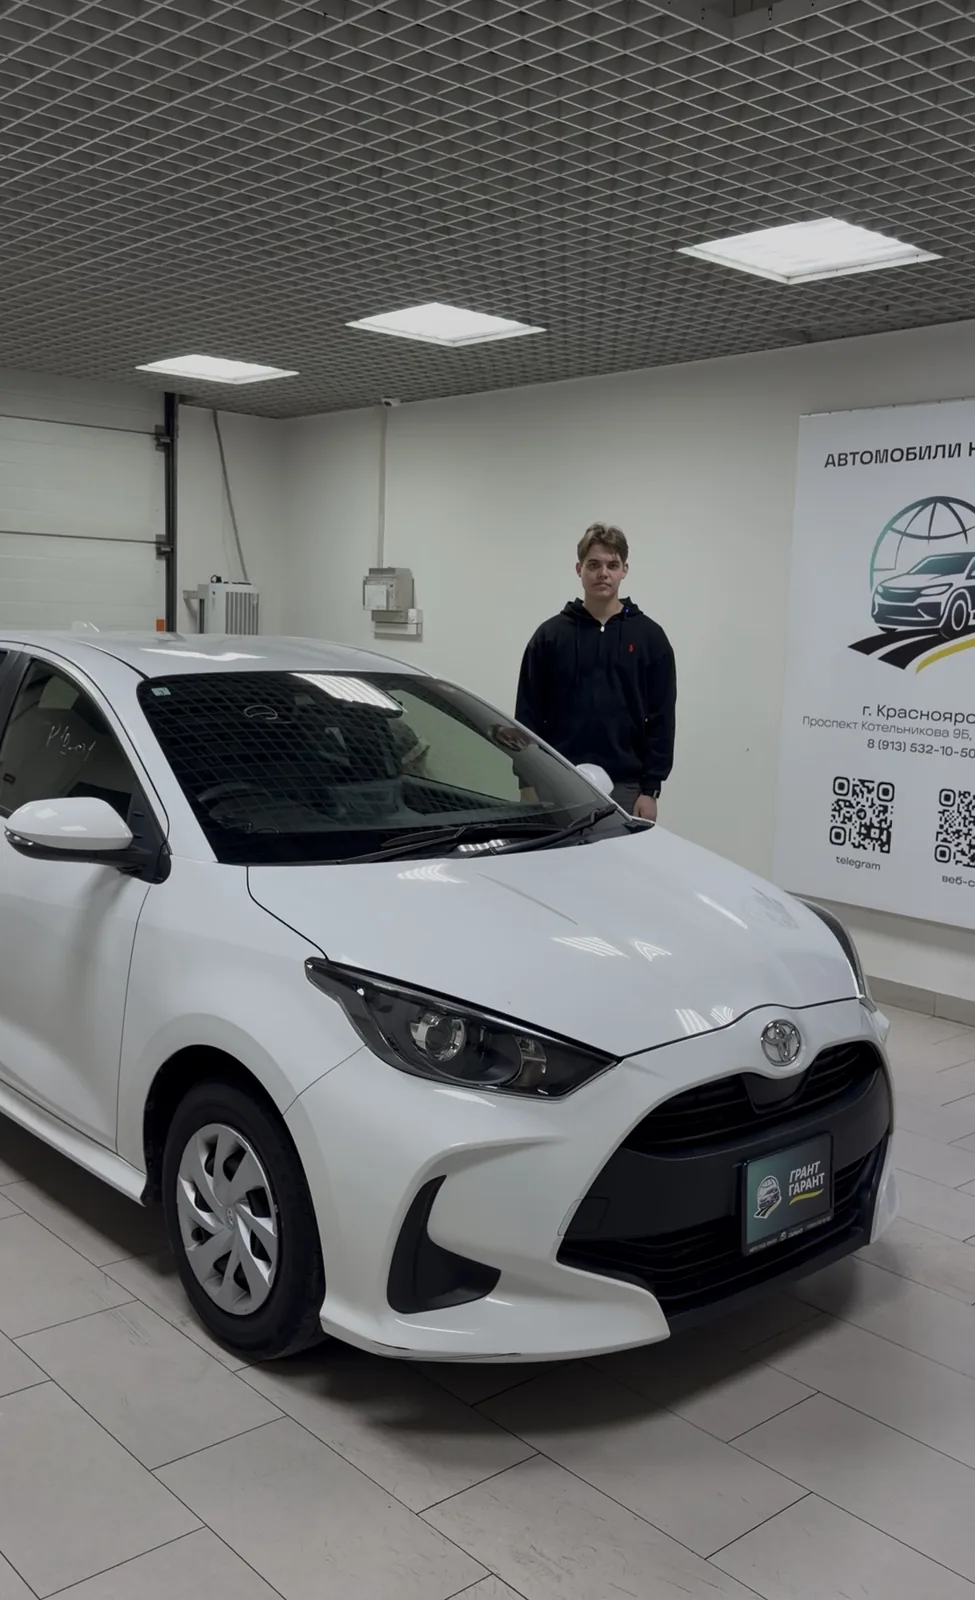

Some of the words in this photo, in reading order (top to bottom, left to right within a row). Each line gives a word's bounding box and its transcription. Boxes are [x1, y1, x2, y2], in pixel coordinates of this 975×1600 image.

[824, 442, 962, 468] АВТОМОБИЛИ
[862, 705, 872, 717] г.
[876, 704, 975, 726] Красноярс
[802, 715, 859, 730] Проспект
[861, 721, 950, 739] Котельникова
[953, 728, 972, 743] 9Б,
[867, 738, 875, 749] 8
[877, 738, 907, 753] (913)
[909, 742, 975, 759] 532-10-50
[835, 855, 881, 871] telegram
[789, 1160, 821, 1183] ГРАНТ
[788, 1172, 825, 1197] ГАРАНТ
